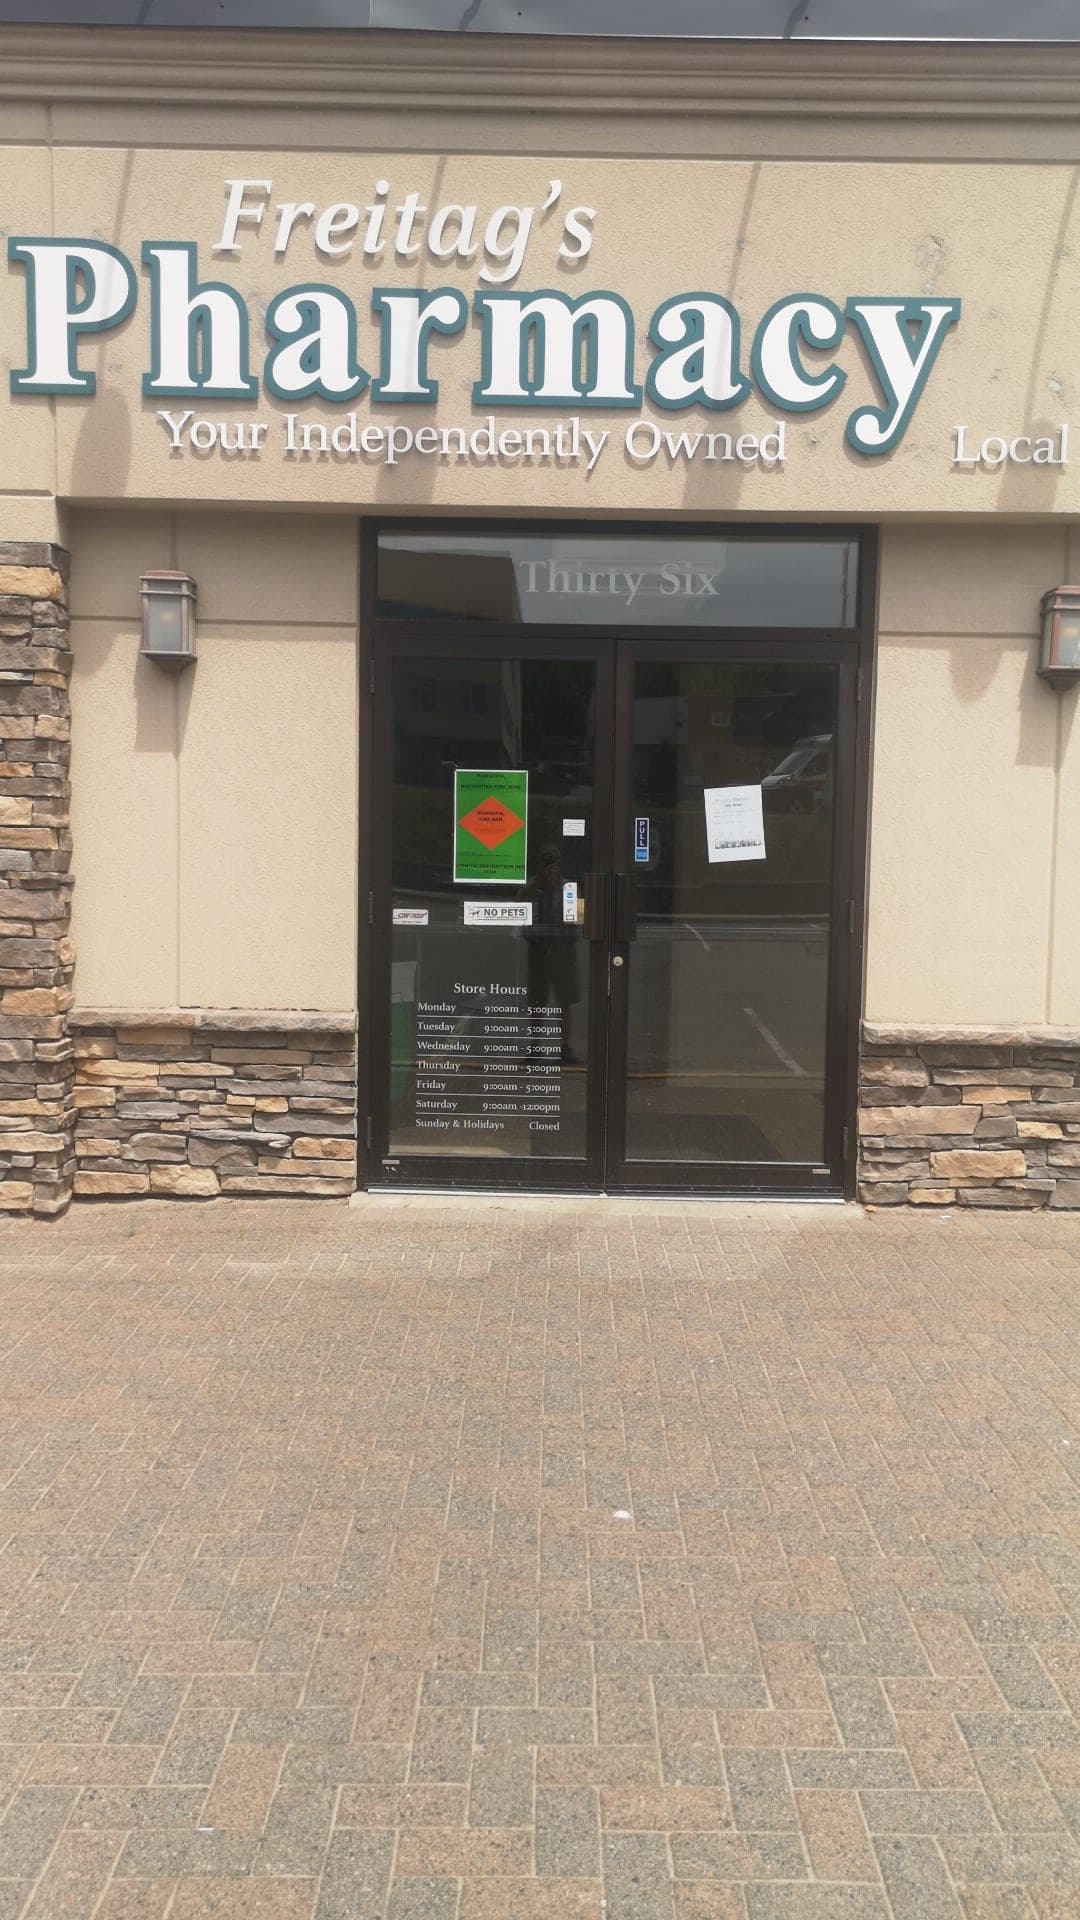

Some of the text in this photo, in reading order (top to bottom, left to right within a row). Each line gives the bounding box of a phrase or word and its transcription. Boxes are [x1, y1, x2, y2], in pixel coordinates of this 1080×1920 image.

[211, 179, 596, 284] Freitag's
[8, 236, 961, 455] Pharmacy
[160, 410, 1069, 470] Your Independently Owned Local
[519, 558, 721, 606] Thirty Six
[483, 908, 525, 917] NO PETS
[453, 982, 528, 995] Store Hours
[417, 1002, 457, 1014] Monday
[485, 1006, 519, 1014] 9:00am
[527, 1006, 562, 1014] 5:00pm
[417, 1022, 456, 1033] Tuesday
[484, 1025, 519, 1034] 9:00am
[527, 1025, 562, 1035] 5:00pm
[417, 1041, 471, 1052] Wednesday
[484, 1044, 518, 1053] 9:00am
[526, 1045, 562, 1054] 5:00pm
[416, 1061, 461, 1072] Thursday
[483, 1063, 518, 1072] 9:00am
[526, 1064, 561, 1073] 5:00pm
[416, 1079, 447, 1091] Friday
[483, 1083, 518, 1091] 9:00am
[526, 1083, 561, 1093] 5:00pm
[416, 1099, 458, 1110] Saturday
[482, 1102, 517, 1111] 9:00am
[416, 1119, 560, 1131] Sunday & Holidays Closed
